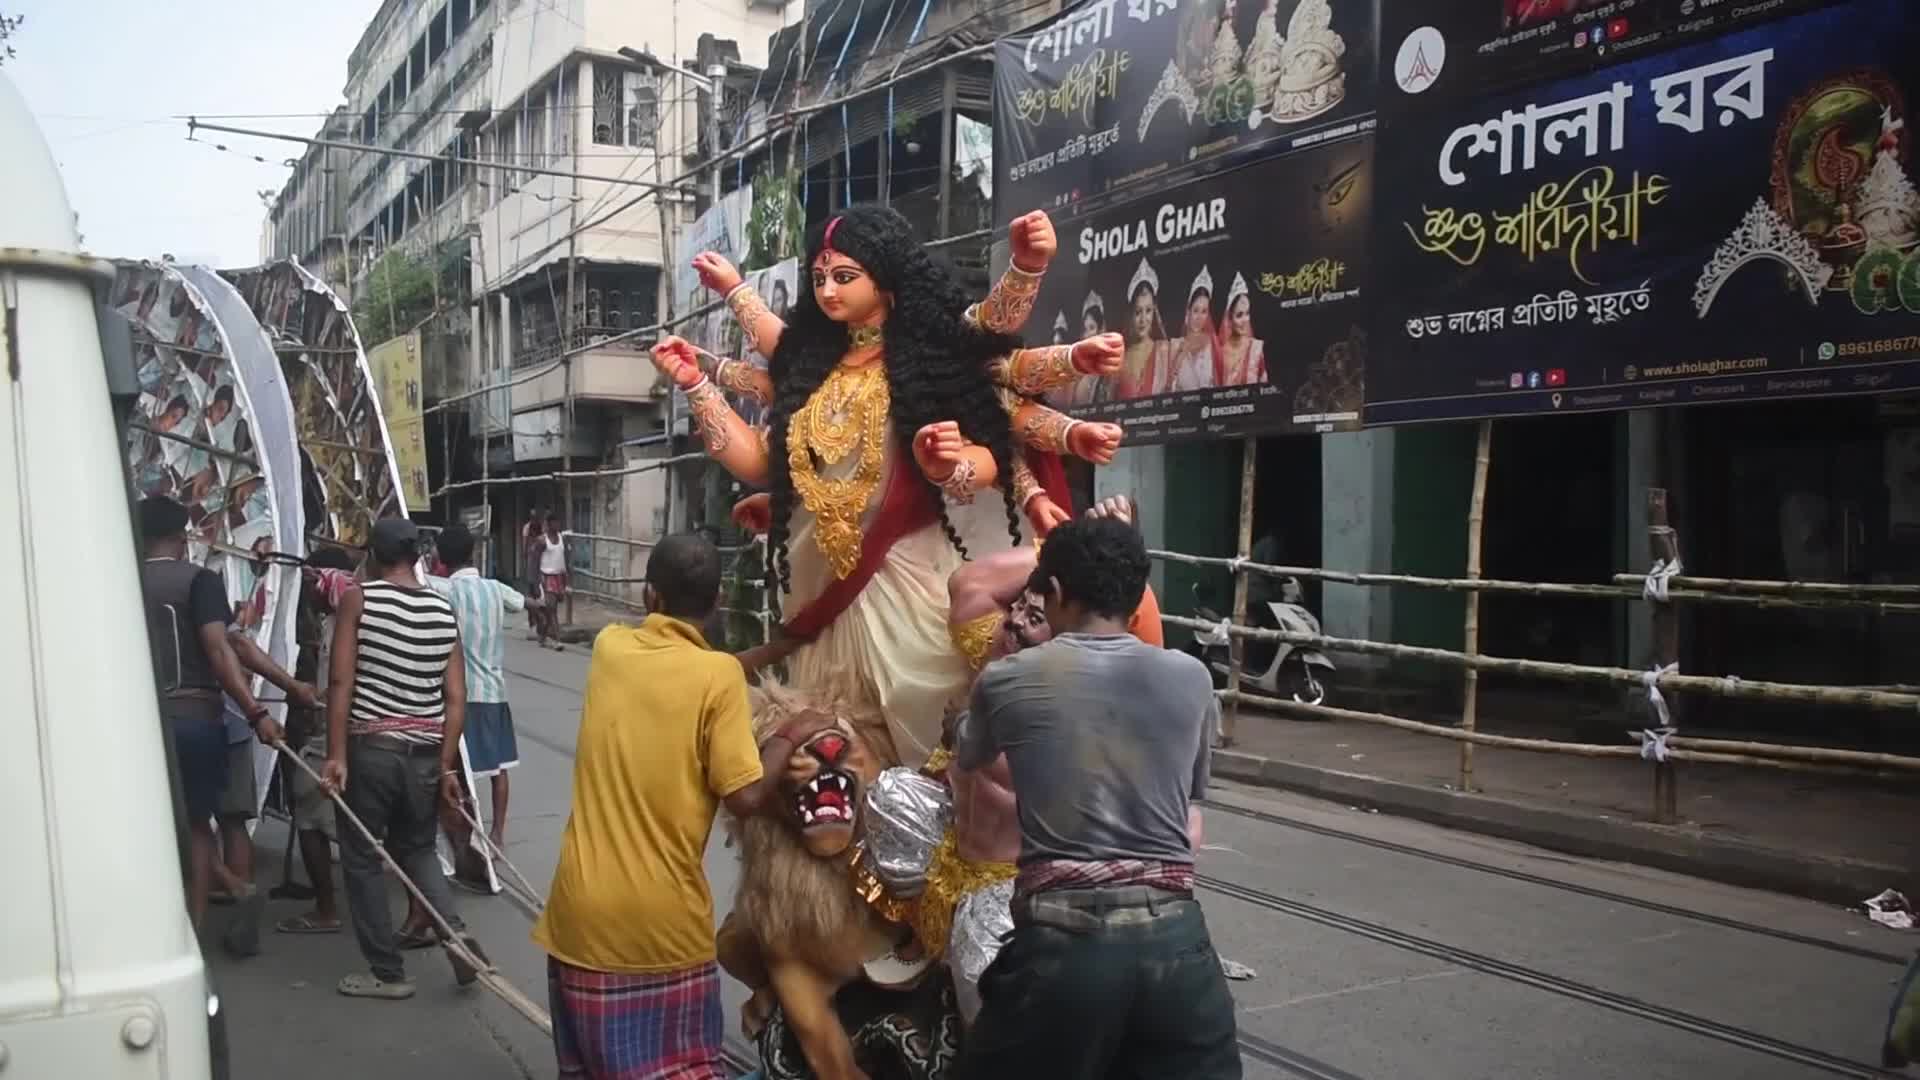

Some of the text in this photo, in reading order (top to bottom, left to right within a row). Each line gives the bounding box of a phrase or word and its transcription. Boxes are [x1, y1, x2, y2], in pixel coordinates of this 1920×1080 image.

[1439, 47, 1775, 186] শোলা ঘর
[1078, 220, 1149, 264] SHOLA
[1156, 198, 1226, 244] GHAR
[1406, 278, 1651, 338] শুভ লগ্নের প্রতিটি মুহূর্তে
[1643, 357, 1769, 378] www.sholaghar.com
[1838, 336, 1920, 356] 896168677
